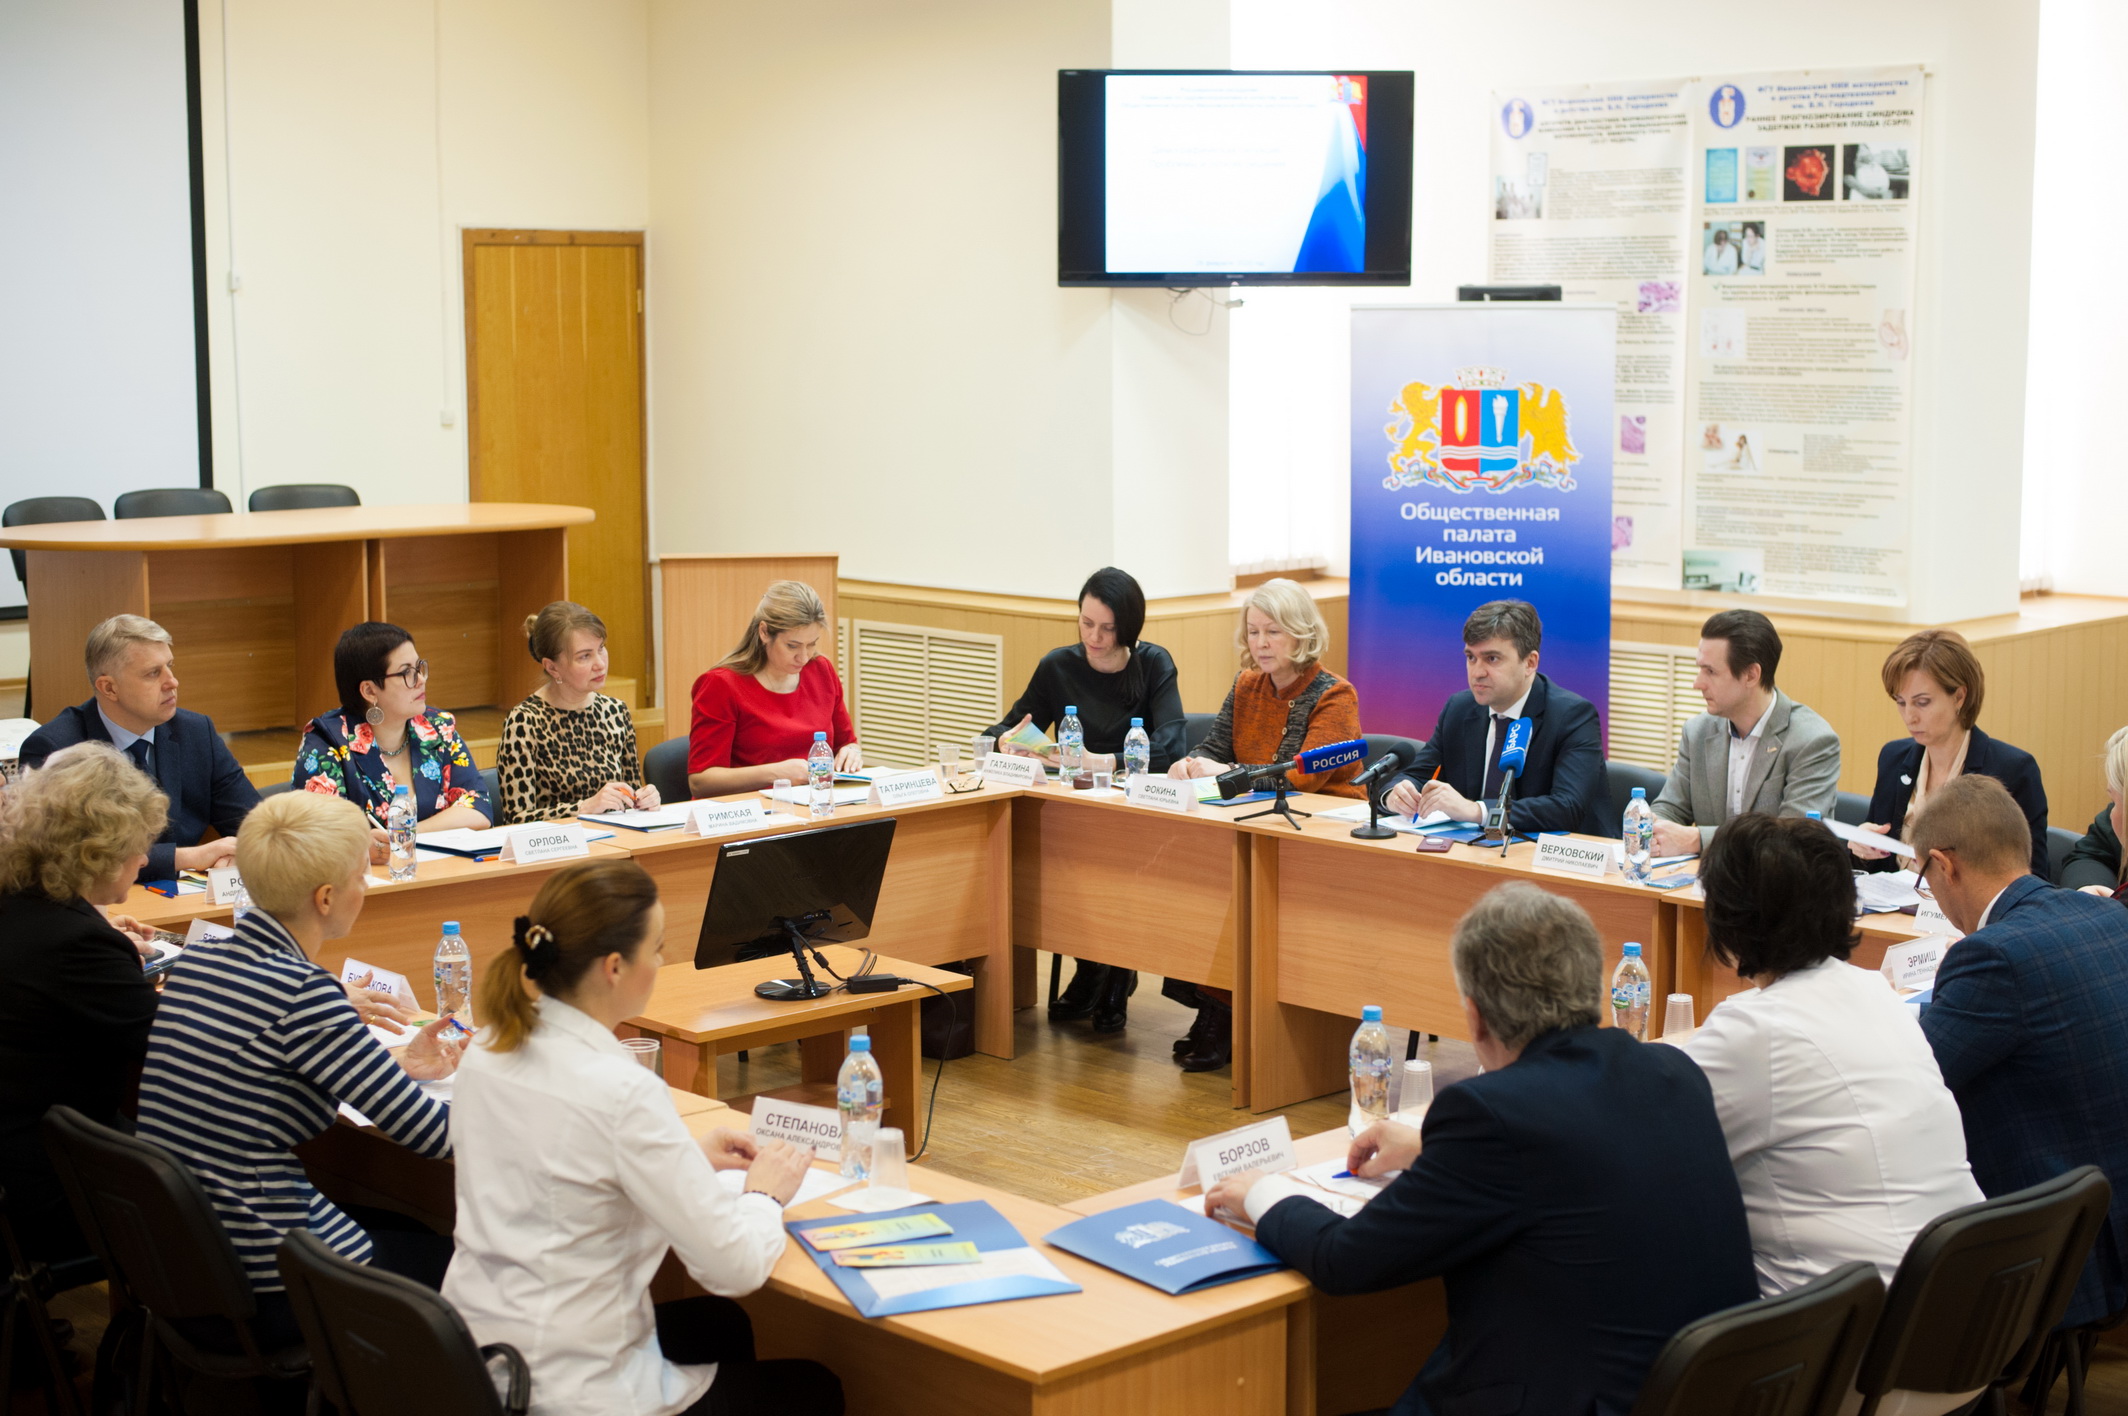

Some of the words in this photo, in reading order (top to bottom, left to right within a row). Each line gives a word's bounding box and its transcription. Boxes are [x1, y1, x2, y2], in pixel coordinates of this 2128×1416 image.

[1400, 502, 1560, 523] Общественная
[1443, 528, 1517, 543] палата
[1415, 546, 1544, 565] Ивановской
[1435, 567, 1523, 586] области
[989, 759, 1030, 773] ГАТАУЛИНА
[1312, 749, 1359, 770] РОССИЯ
[878, 777, 937, 794] ТАТАРИНЦЕВА
[1144, 785, 1177, 797] ФОКИНА
[708, 808, 752, 821] РИМСКАЯ
[528, 834, 570, 847] ОРЛОВА
[524, 848, 550, 856] СВЕТЛАНА
[1541, 843, 1605, 863] ВЕРХОВСКИЙ
[1541, 855, 1565, 864] ДМИТРИЙ
[1565, 859, 1599, 870] НИКОЛАЕВИЧ
[1920, 910, 1948, 921] ИГУМЕ
[1907, 950, 1937, 968] ЭРМИШ
[755, 1127, 785, 1140] ОКСАНА
[786, 1133, 841, 1151] АЛЕКСАНДРОВ
[1219, 1137, 1270, 1166] БОРЗОВ
